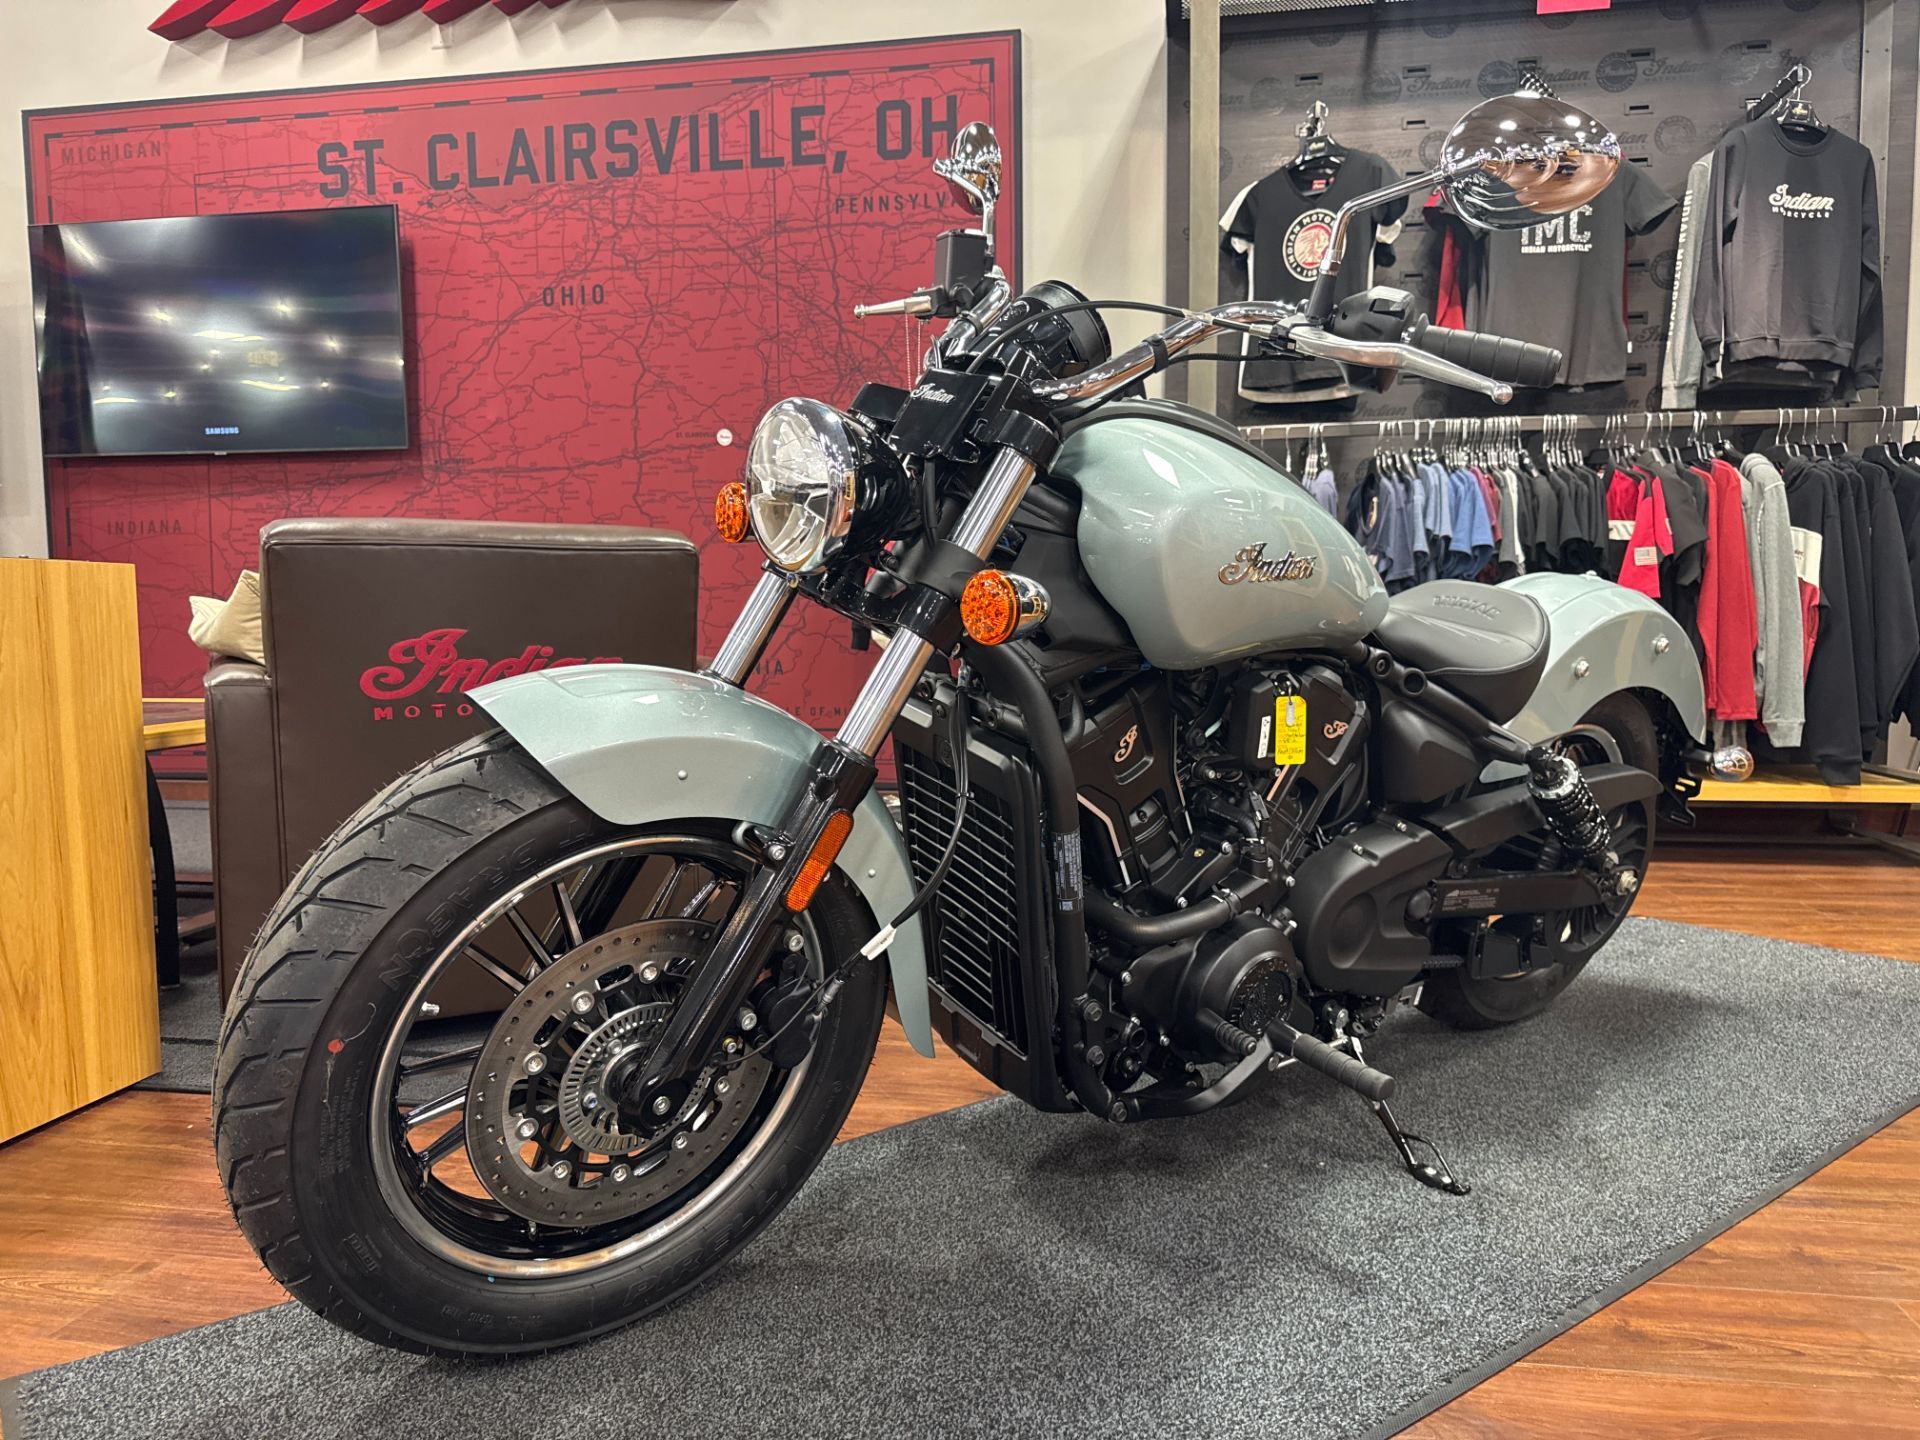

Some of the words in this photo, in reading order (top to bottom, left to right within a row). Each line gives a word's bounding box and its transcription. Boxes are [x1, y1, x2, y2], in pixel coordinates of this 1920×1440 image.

[61, 141, 162, 165] MICHIGAN
[318, 139, 404, 198] ST.
[427, 105, 848, 191] CLAIRSVILLE,
[876, 95, 958, 160] OH
[835, 191, 958, 214] PENNSYLV
[1678, 189, 1693, 243] INDIAN
[542, 284, 605, 307] OHIO
[910, 383, 955, 404] Indian
[204, 425, 240, 435] SAMSUNG
[107, 519, 183, 536] INDIANA
[1218, 541, 1317, 585] Indian
